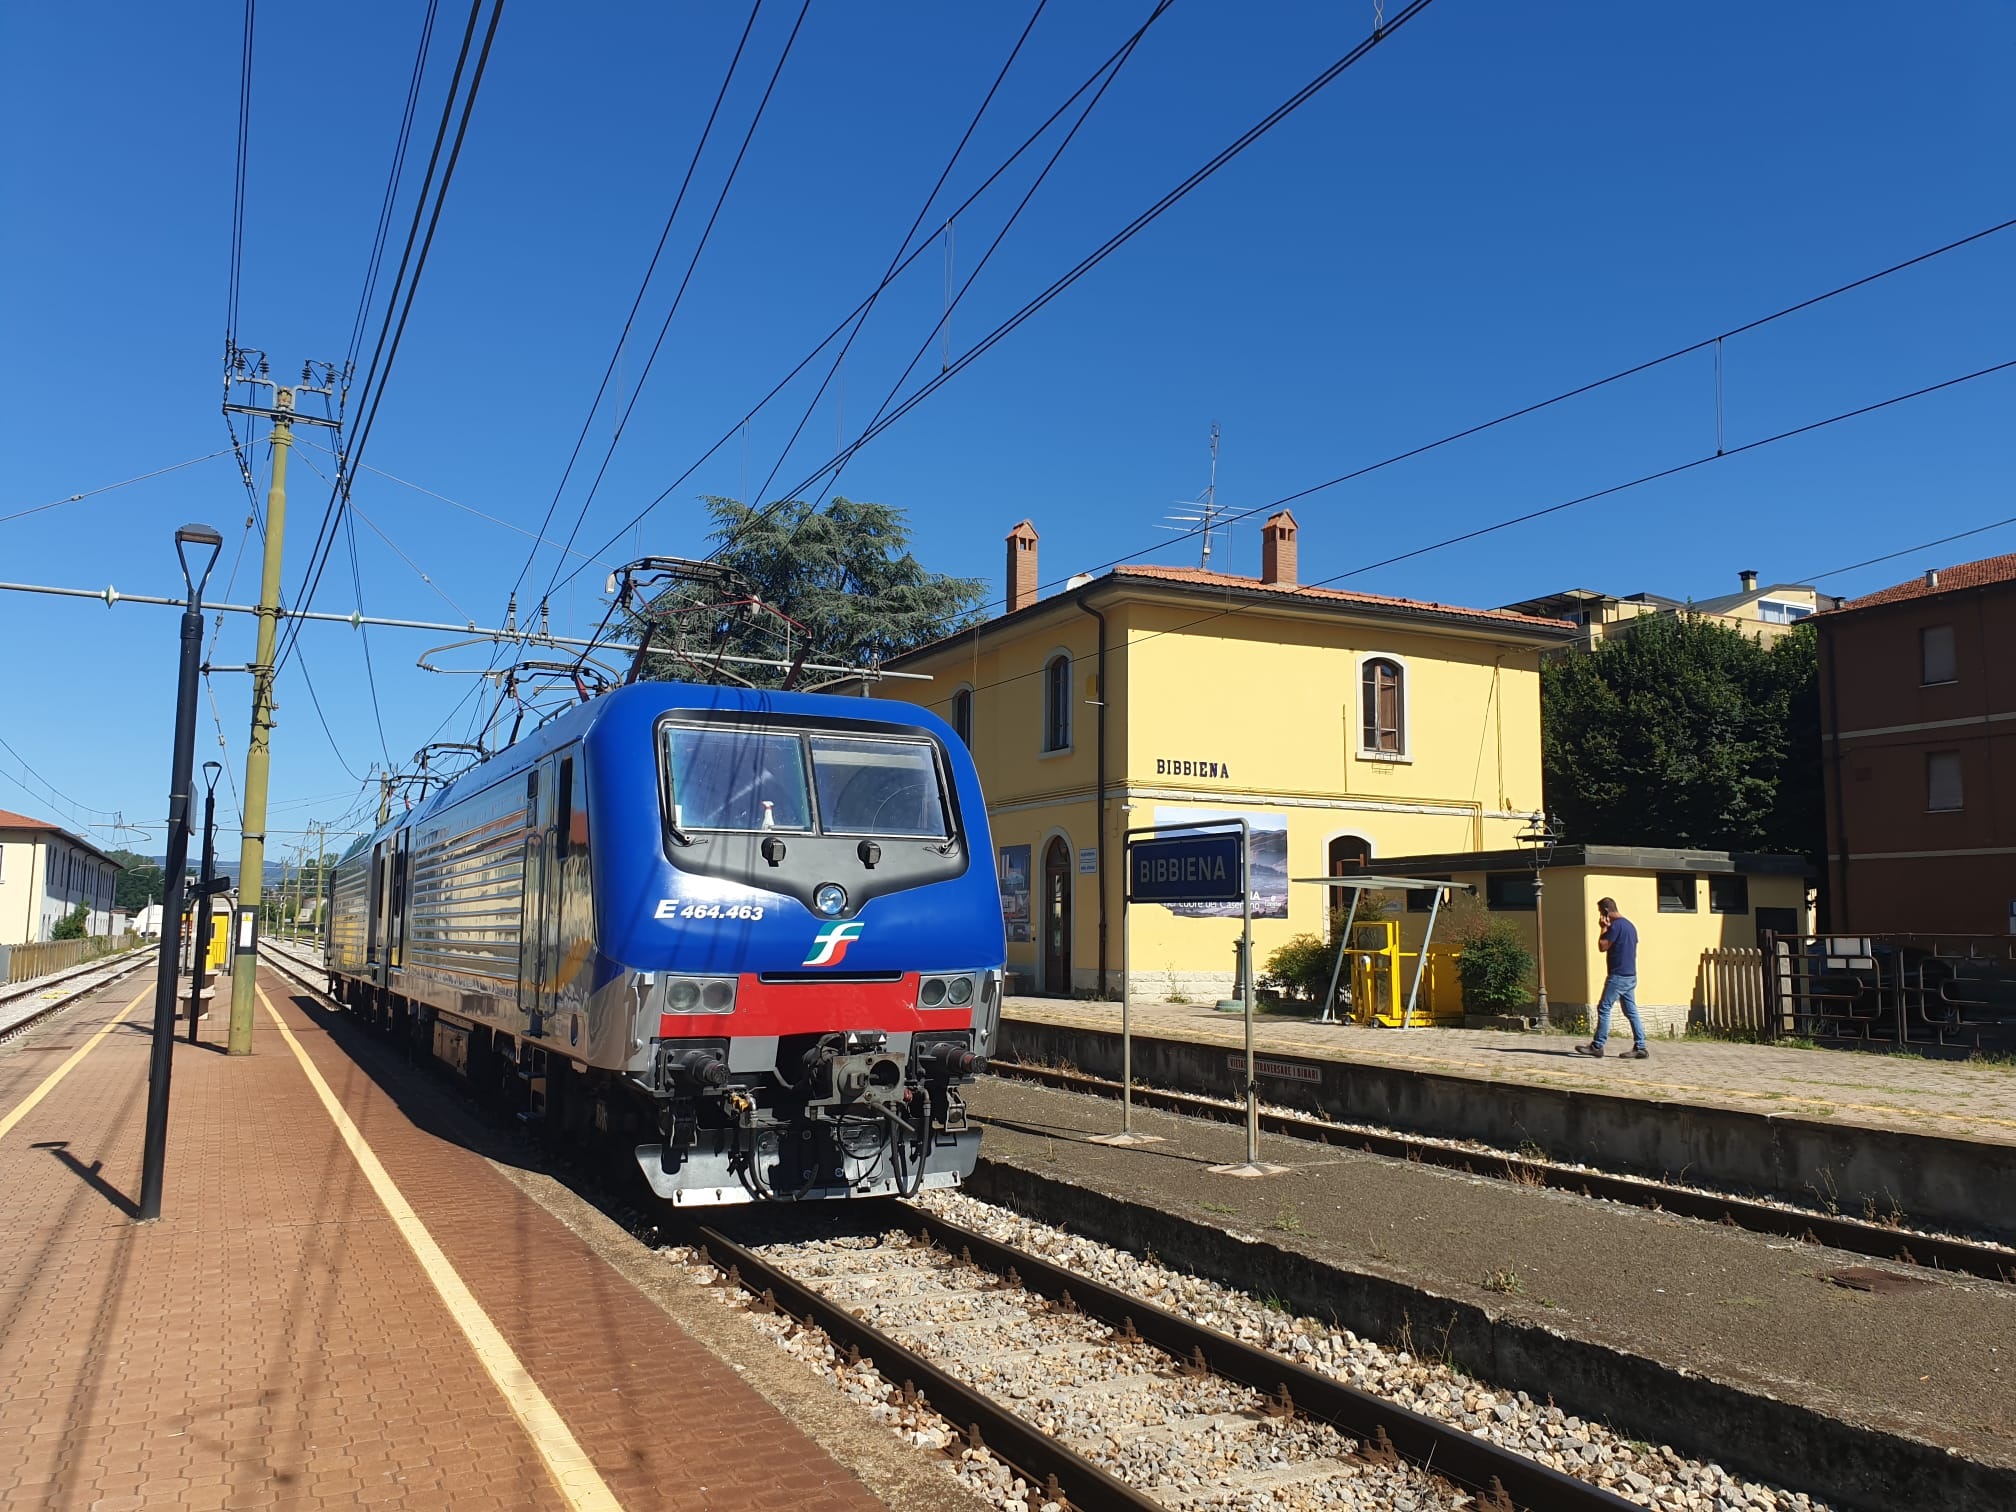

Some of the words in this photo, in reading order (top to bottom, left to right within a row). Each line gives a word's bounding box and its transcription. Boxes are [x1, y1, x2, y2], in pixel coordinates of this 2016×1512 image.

[1156, 758, 1229, 779] BIBBIENA
[1139, 855, 1226, 883] BIBBIENA
[654, 899, 680, 919] E
[680, 904, 765, 921] 464.463
